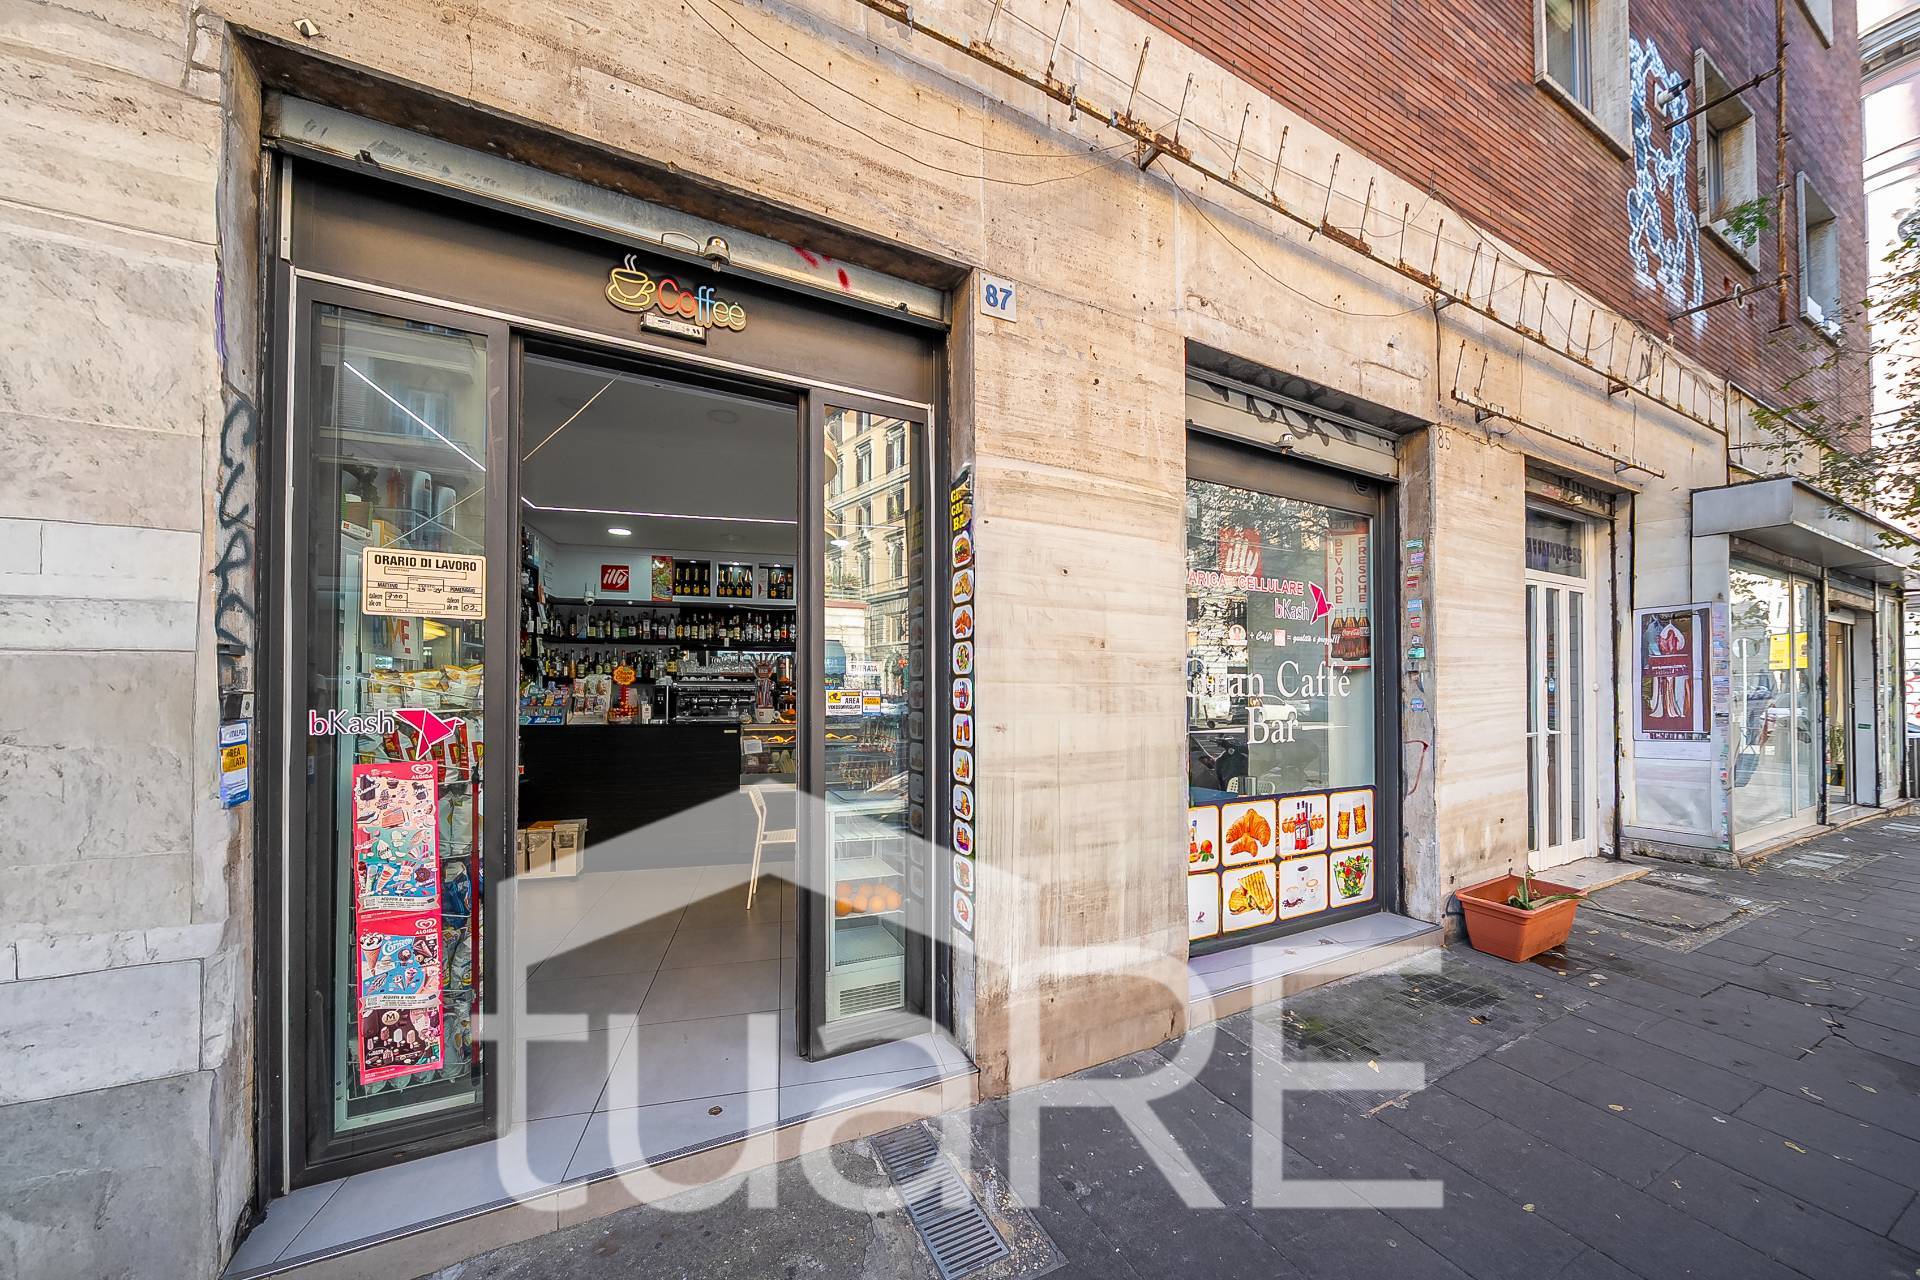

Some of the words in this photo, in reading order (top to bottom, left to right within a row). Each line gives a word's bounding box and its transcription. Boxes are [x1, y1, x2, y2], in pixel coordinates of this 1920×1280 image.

[657, 278, 746, 327] Coffee
[985, 283, 1013, 311] 87
[374, 554, 417, 568] ORARIO
[420, 557, 432, 568] DI
[435, 560, 477, 572] LAVORO
[1334, 538, 1345, 604] BEVANDE
[1358, 536, 1368, 603] FRESCHE
[602, 568, 629, 589] illy
[1186, 568, 1227, 588] ARICA
[1238, 575, 1305, 596] CELLULARE
[1274, 598, 1310, 621] bKash
[1276, 660, 1352, 698] Caffé
[308, 709, 395, 736] bKash
[1245, 706, 1299, 744] Bar
